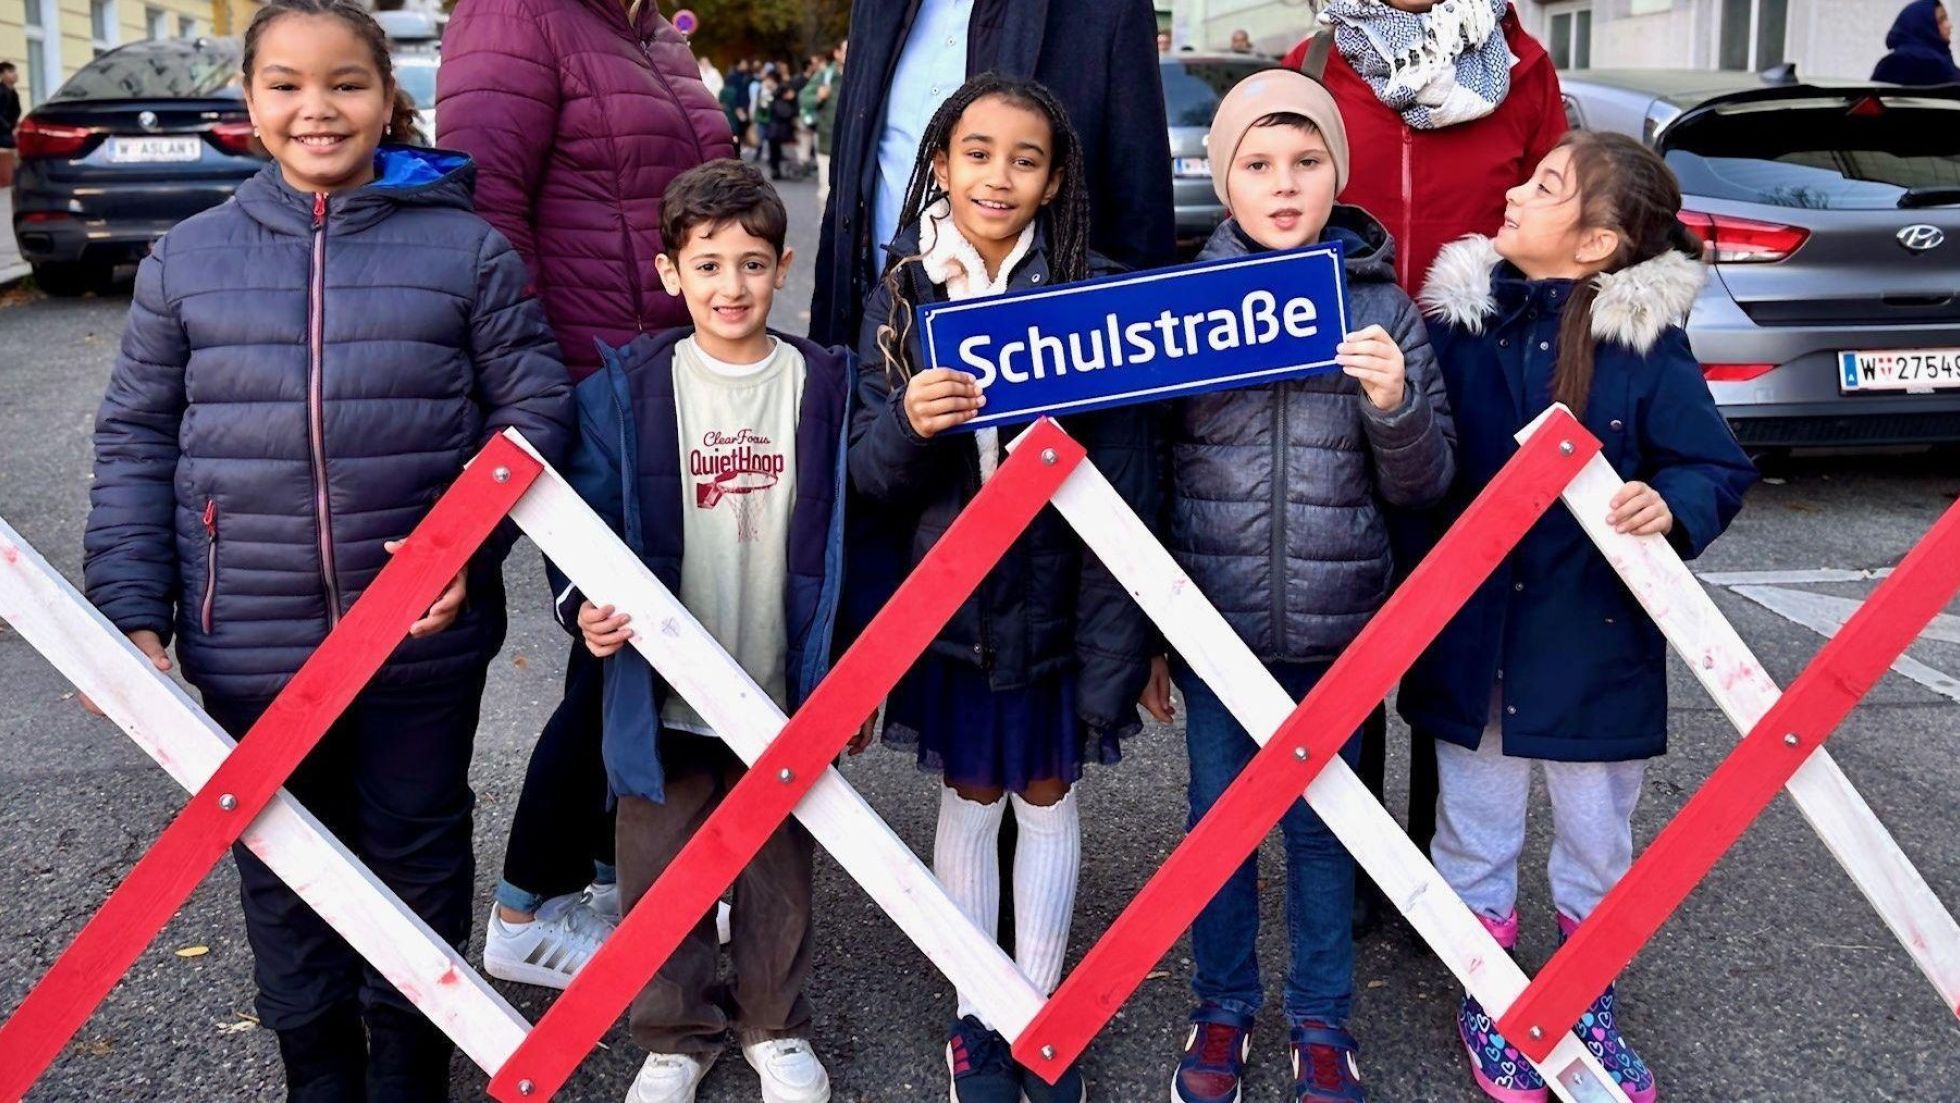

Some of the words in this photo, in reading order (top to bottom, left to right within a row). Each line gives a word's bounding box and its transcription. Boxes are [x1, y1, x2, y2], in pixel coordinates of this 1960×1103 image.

[119, 143, 129, 154] W
[958, 289, 1318, 389] Schulstraße
[1860, 357, 1876, 381] W
